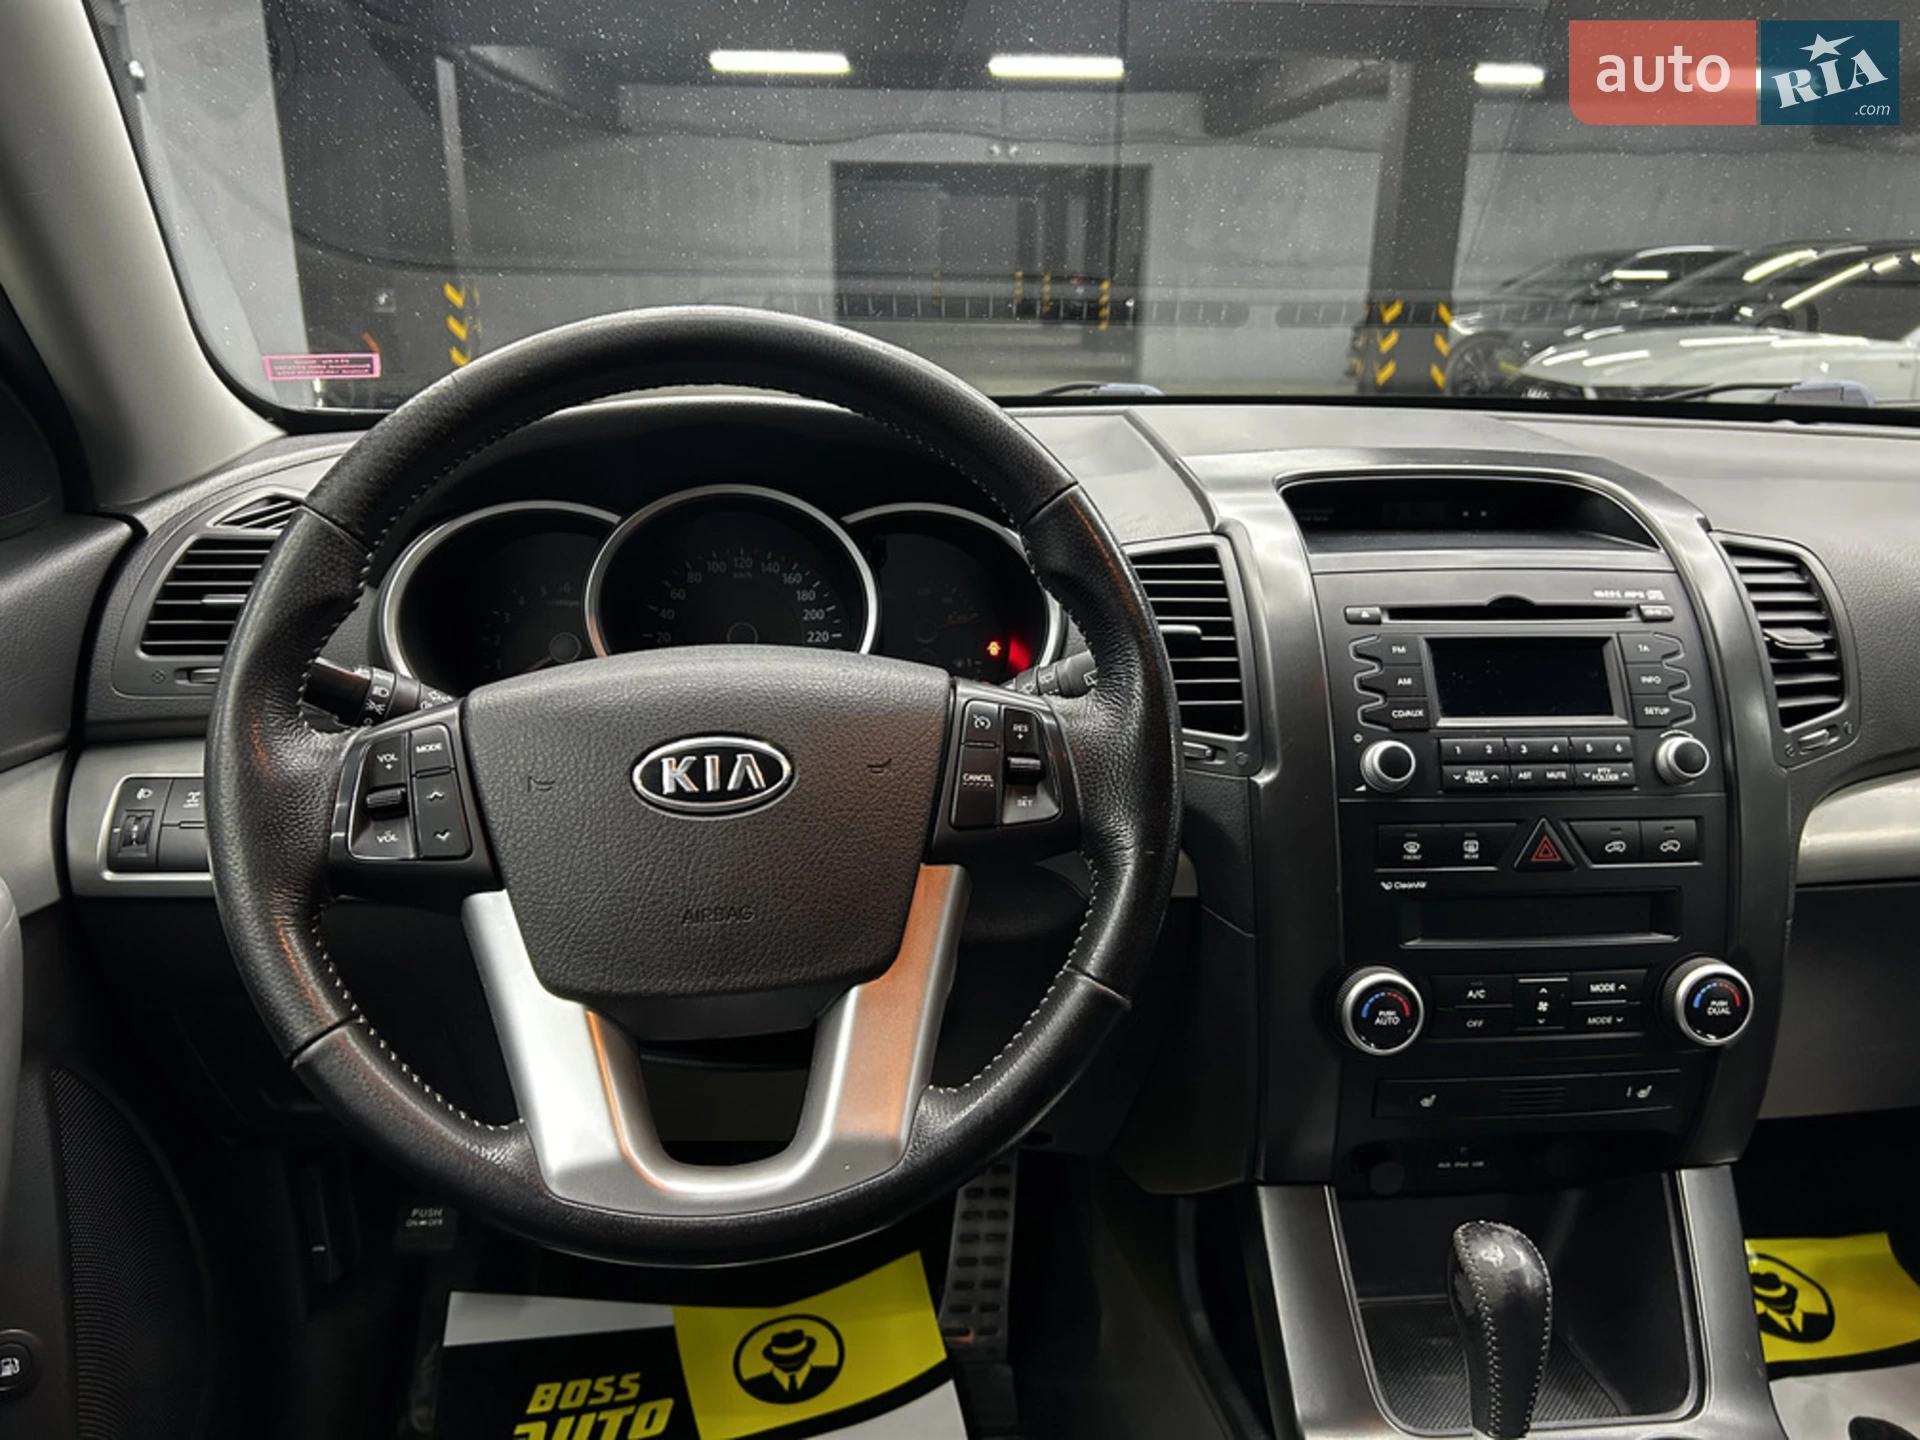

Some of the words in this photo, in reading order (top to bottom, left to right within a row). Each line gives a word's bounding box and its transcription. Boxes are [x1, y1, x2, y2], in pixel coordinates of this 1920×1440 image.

[782, 573, 802, 584] 160
[796, 589, 816, 601] 180
[802, 608, 825, 620] 200
[807, 631, 829, 642] 220
[1391, 645, 1406, 654] FM
[1397, 677, 1412, 686] AM
[1640, 675, 1662, 685] INFO
[1644, 706, 1670, 715] SETUP
[1012, 723, 1028, 732] RES
[415, 742, 442, 753] MODE
[376, 753, 398, 763] VOL
[661, 753, 767, 795] KIA
[962, 773, 993, 782] CANCEL
[1546, 771, 1567, 780] MUTE
[1591, 774, 1619, 782] FOLDER
[1464, 776, 1489, 784] TRACK
[1017, 799, 1032, 807] SET
[376, 833, 399, 843] VOL
[681, 906, 757, 927] AIRBAG
[1590, 983, 1615, 993] MODE
[1466, 989, 1486, 999] A/C
[1707, 1006, 1731, 1015] DUAL
[1374, 1016, 1400, 1026] AUTO
[1466, 1020, 1484, 1028] OFF
[1587, 1016, 1613, 1025] MODE
[409, 1207, 443, 1218] PUSH
[525, 1371, 642, 1415] BOSS
